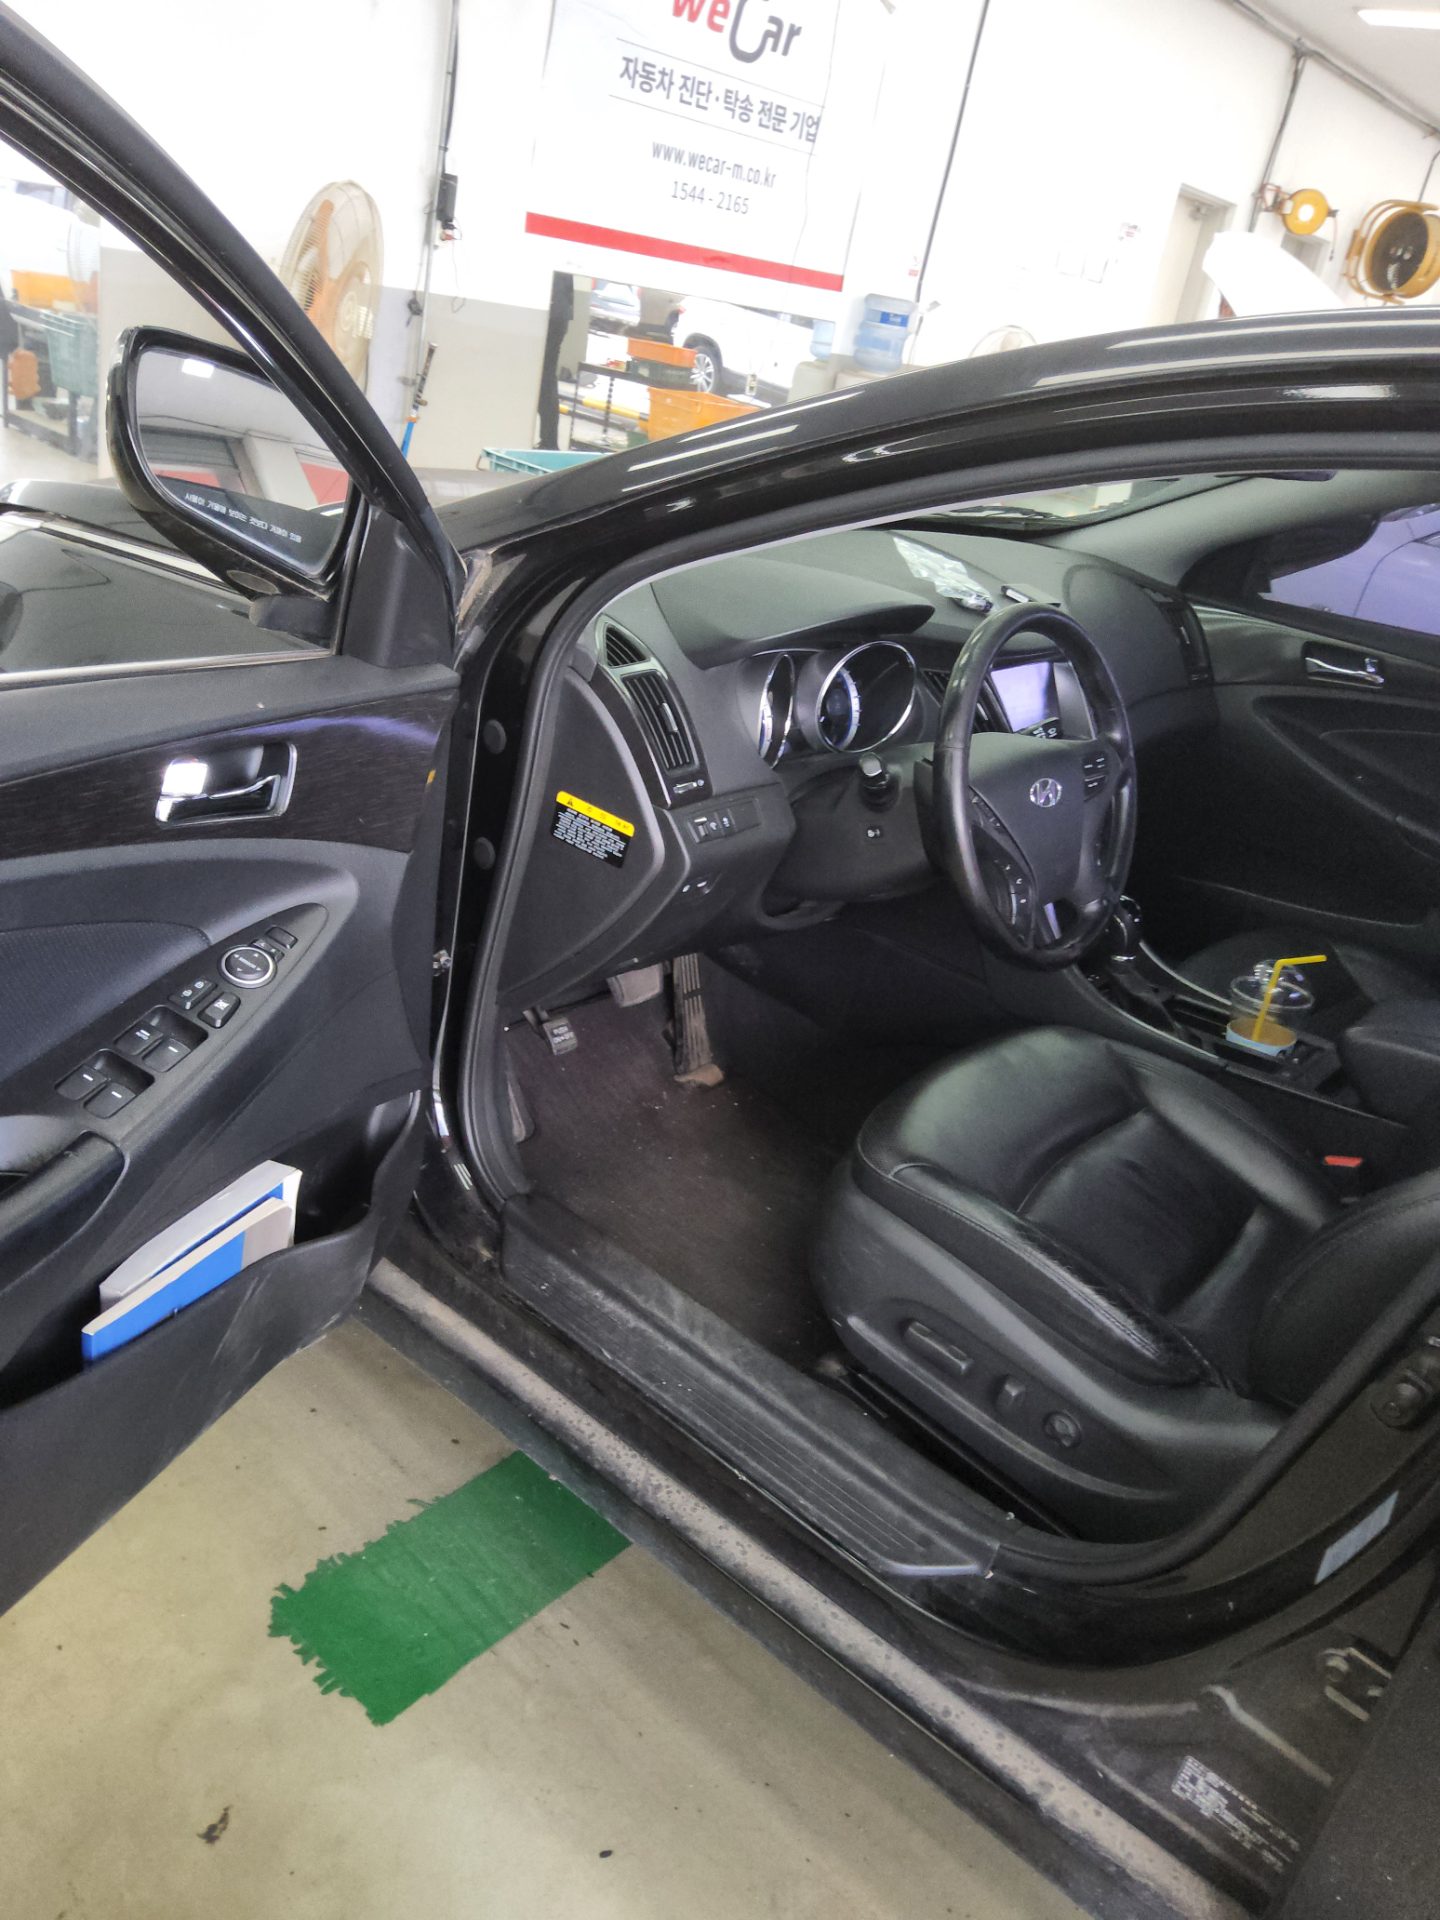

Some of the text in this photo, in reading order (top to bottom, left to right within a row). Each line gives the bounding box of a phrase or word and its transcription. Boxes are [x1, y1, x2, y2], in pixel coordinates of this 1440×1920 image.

[619, 55, 675, 100] 자동차
[757, 99, 788, 133] 전문
[789, 111, 821, 143] 기업
[651, 140, 777, 189] www.wecar-m.co.kr
